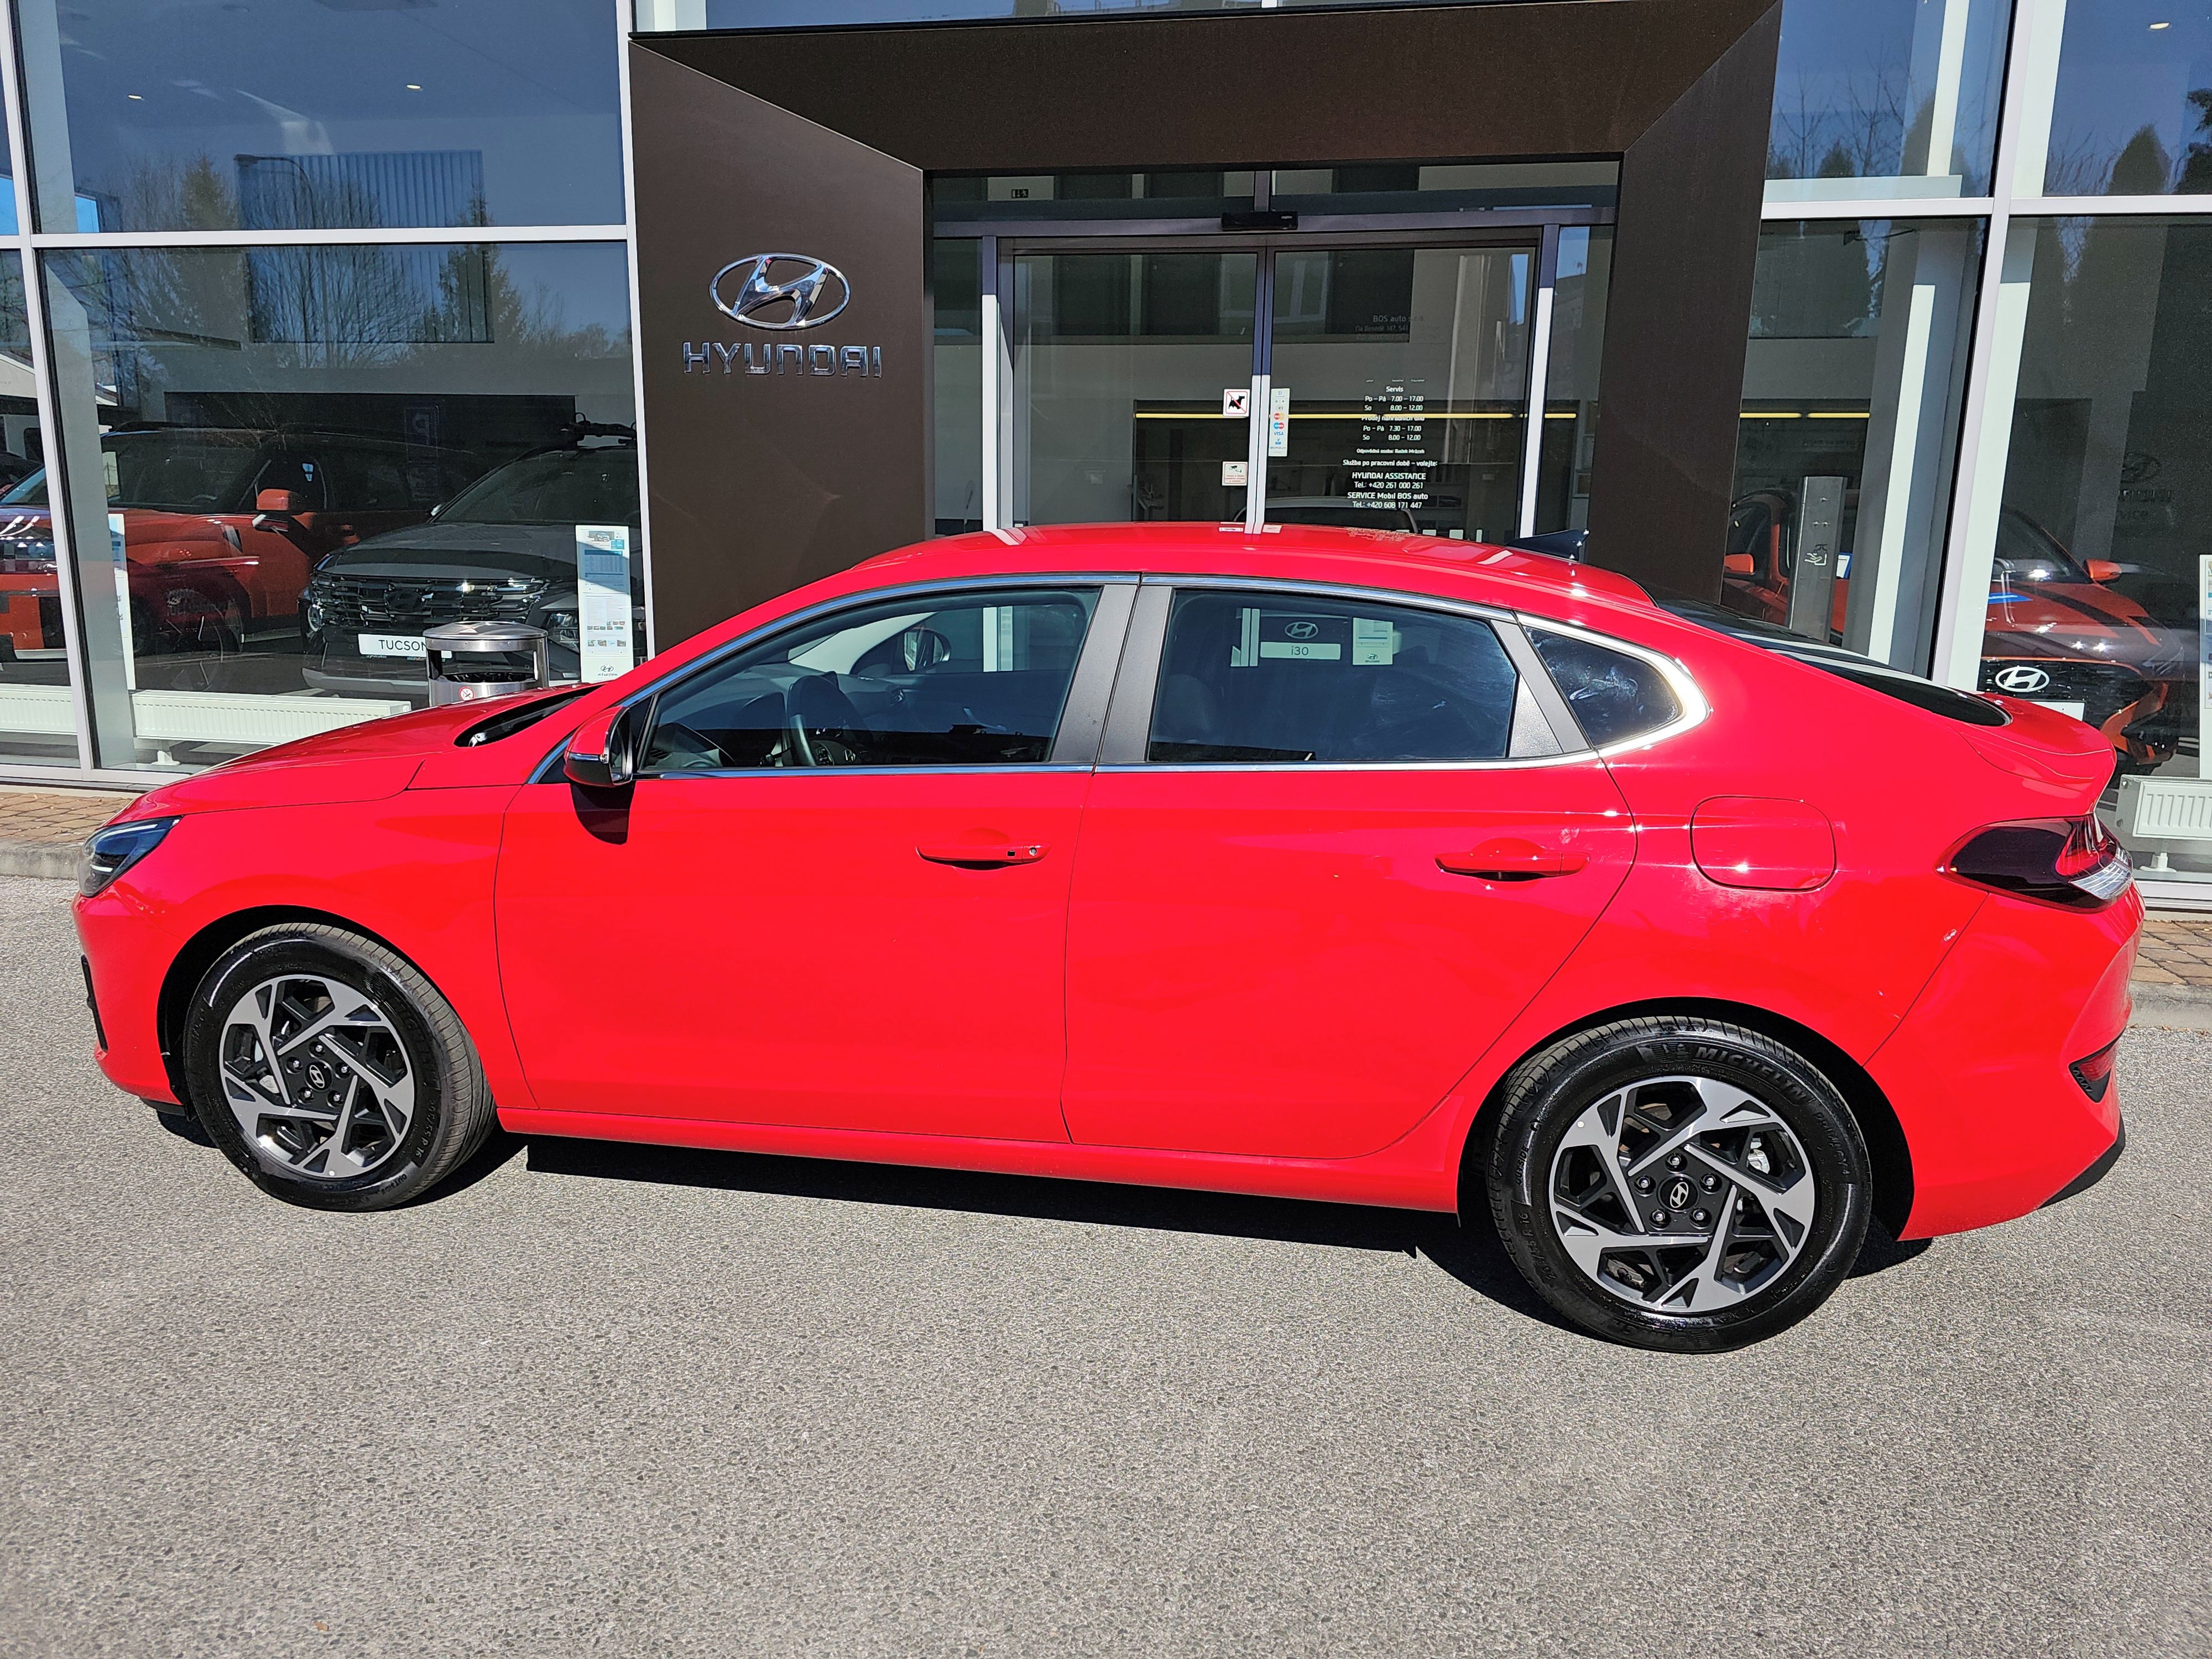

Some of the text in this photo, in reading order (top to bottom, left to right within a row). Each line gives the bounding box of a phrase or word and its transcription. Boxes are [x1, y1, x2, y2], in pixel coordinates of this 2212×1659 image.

[682, 341, 882, 378] HYUNDAI
[378, 639, 426, 651] TUCSON
[1291, 645, 1309, 655] i30
[1695, 1046, 1807, 1104] MICHELIN
[415, 1147, 425, 1158] 16
[1519, 1212, 1530, 1224] 16
